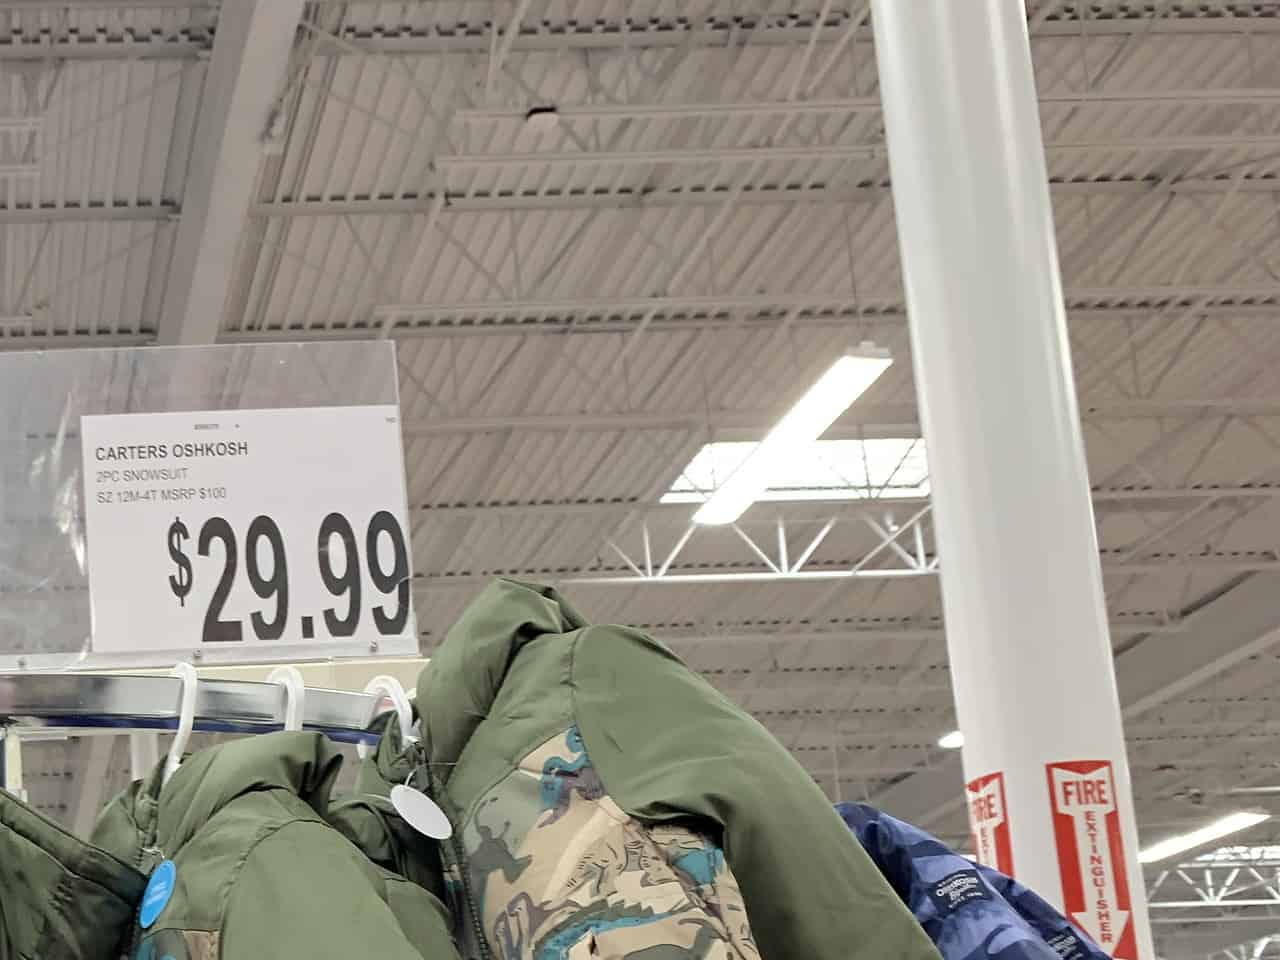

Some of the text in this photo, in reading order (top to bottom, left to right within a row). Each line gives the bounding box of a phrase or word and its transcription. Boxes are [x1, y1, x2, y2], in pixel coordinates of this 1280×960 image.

[95, 441, 248, 461] CARTERS OSHKOSH
[96, 467, 188, 483] 2PC SNOWSUIT
[97, 486, 226, 504] SZ 12M-4T MSRP $100
[167, 510, 410, 642] $29.99
[1061, 780, 1108, 806] FIRE
[1084, 811, 1113, 943] EXTINGUISHER
